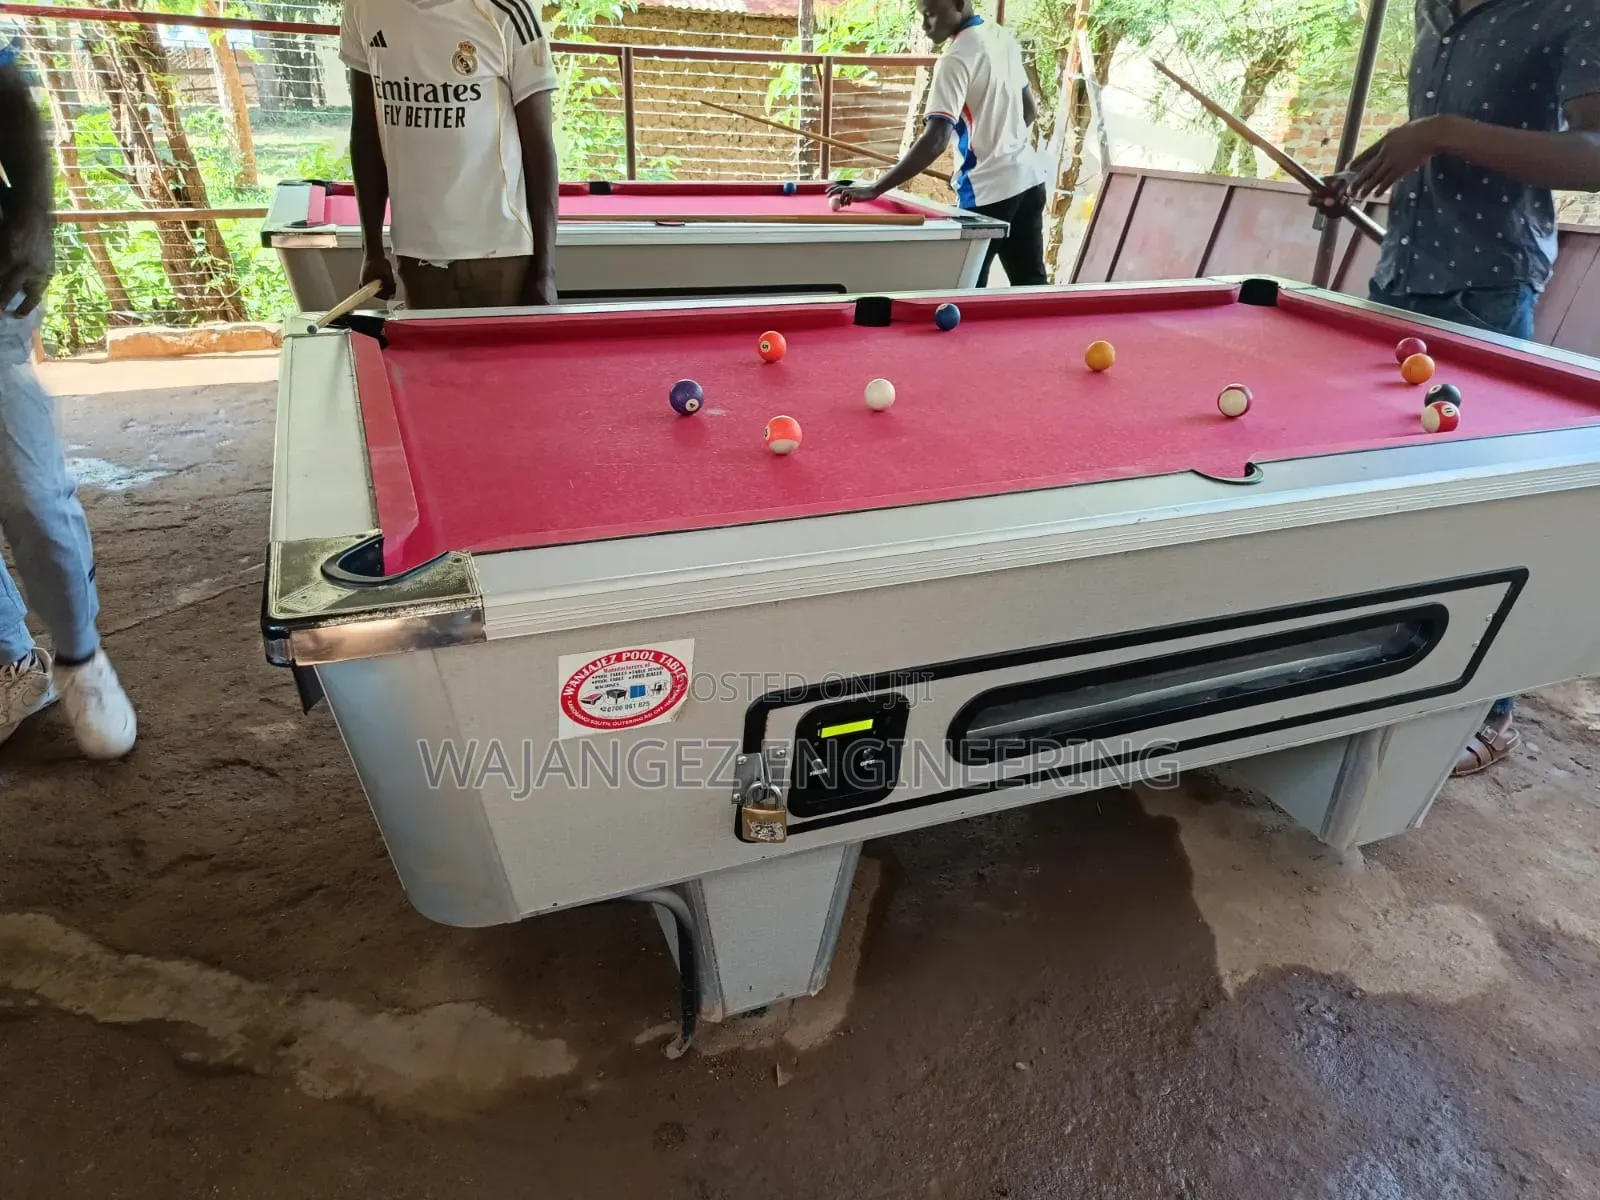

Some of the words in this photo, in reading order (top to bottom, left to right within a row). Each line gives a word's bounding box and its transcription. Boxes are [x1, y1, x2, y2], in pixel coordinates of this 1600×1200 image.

[374, 75, 482, 104] Emirates
[384, 104, 402, 126] FLY
[405, 106, 466, 129] BETTER
[622, 650, 656, 662] POOL
